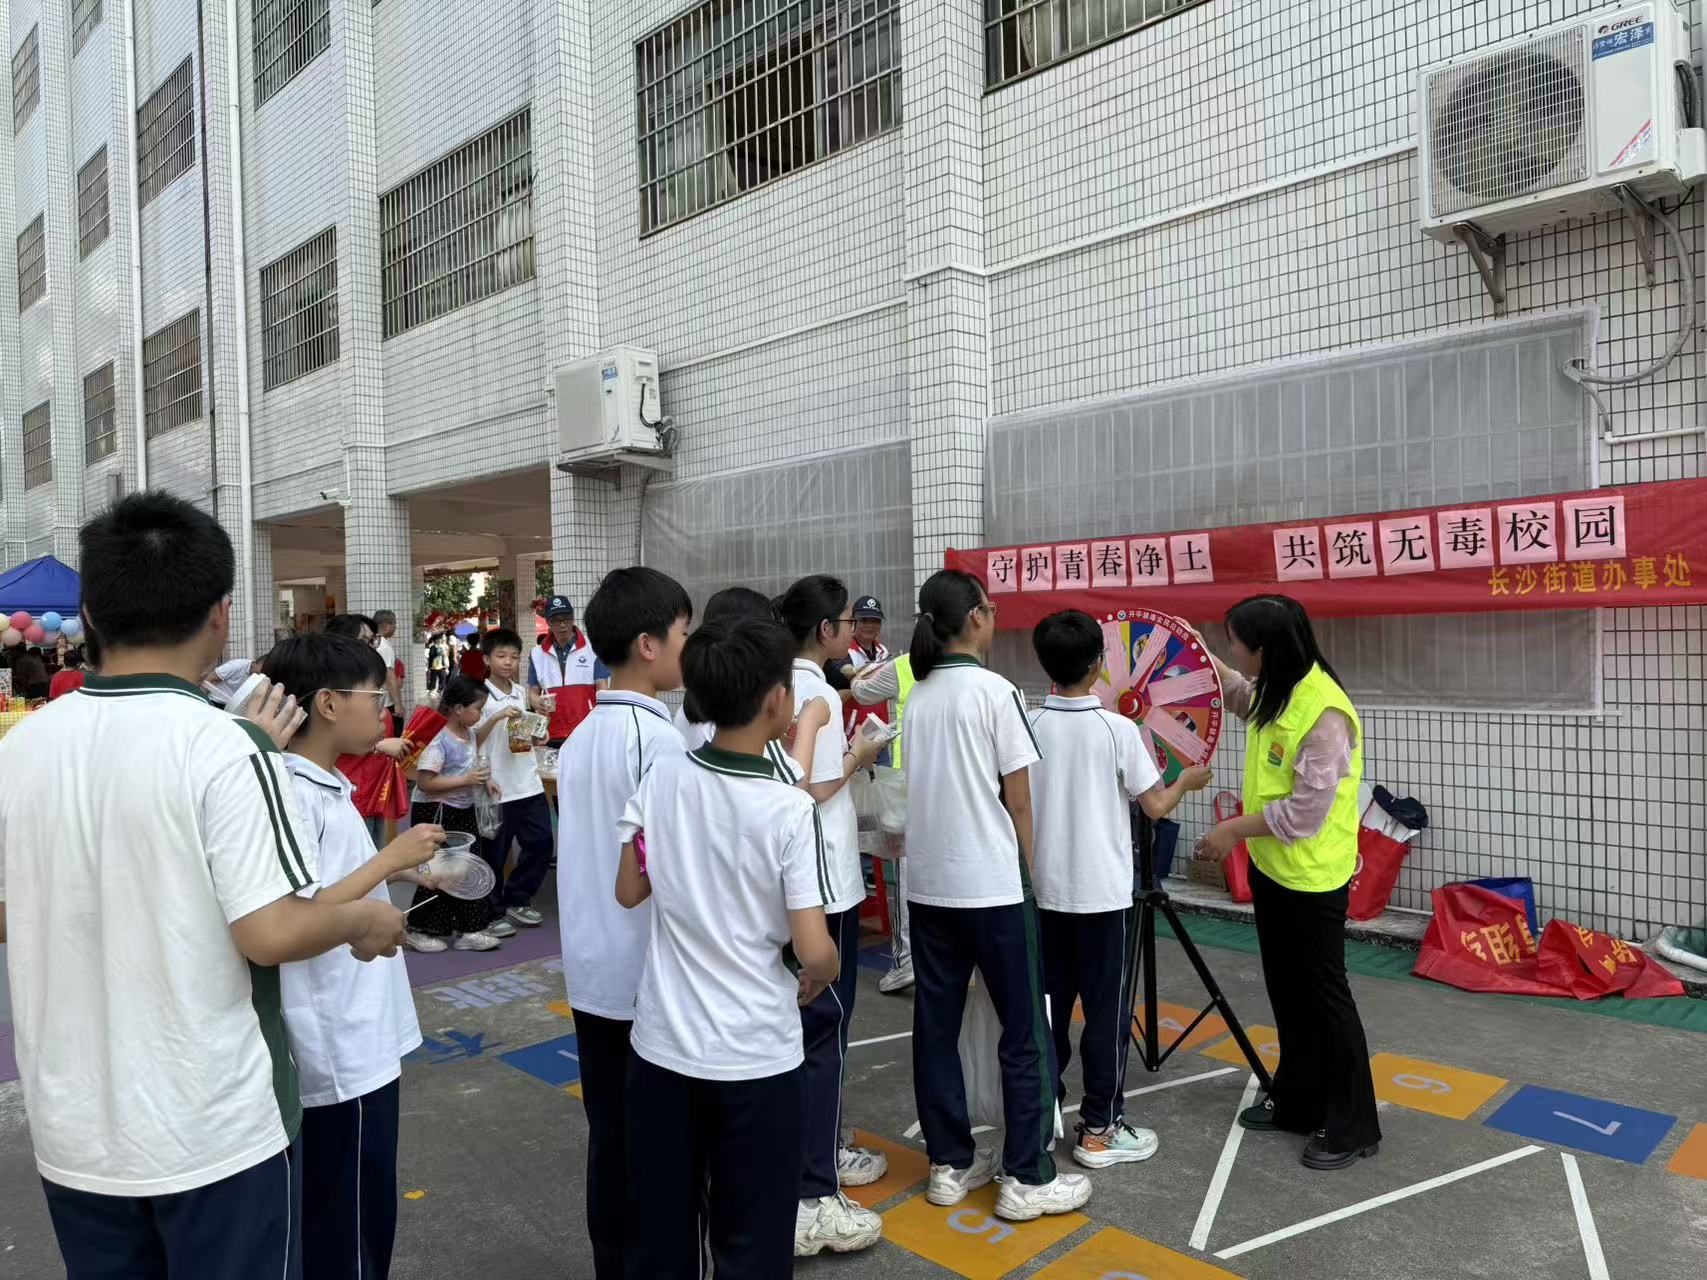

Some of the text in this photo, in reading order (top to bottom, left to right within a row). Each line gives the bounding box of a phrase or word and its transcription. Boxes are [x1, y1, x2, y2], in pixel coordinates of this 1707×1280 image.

[1611, 15, 1644, 31] GREE
[991, 504, 1616, 584] 守护青春净土 共筑无毒校园
[1488, 553, 1693, 597] 长沙街道办事处
[947, 1208, 1017, 1245] 5
